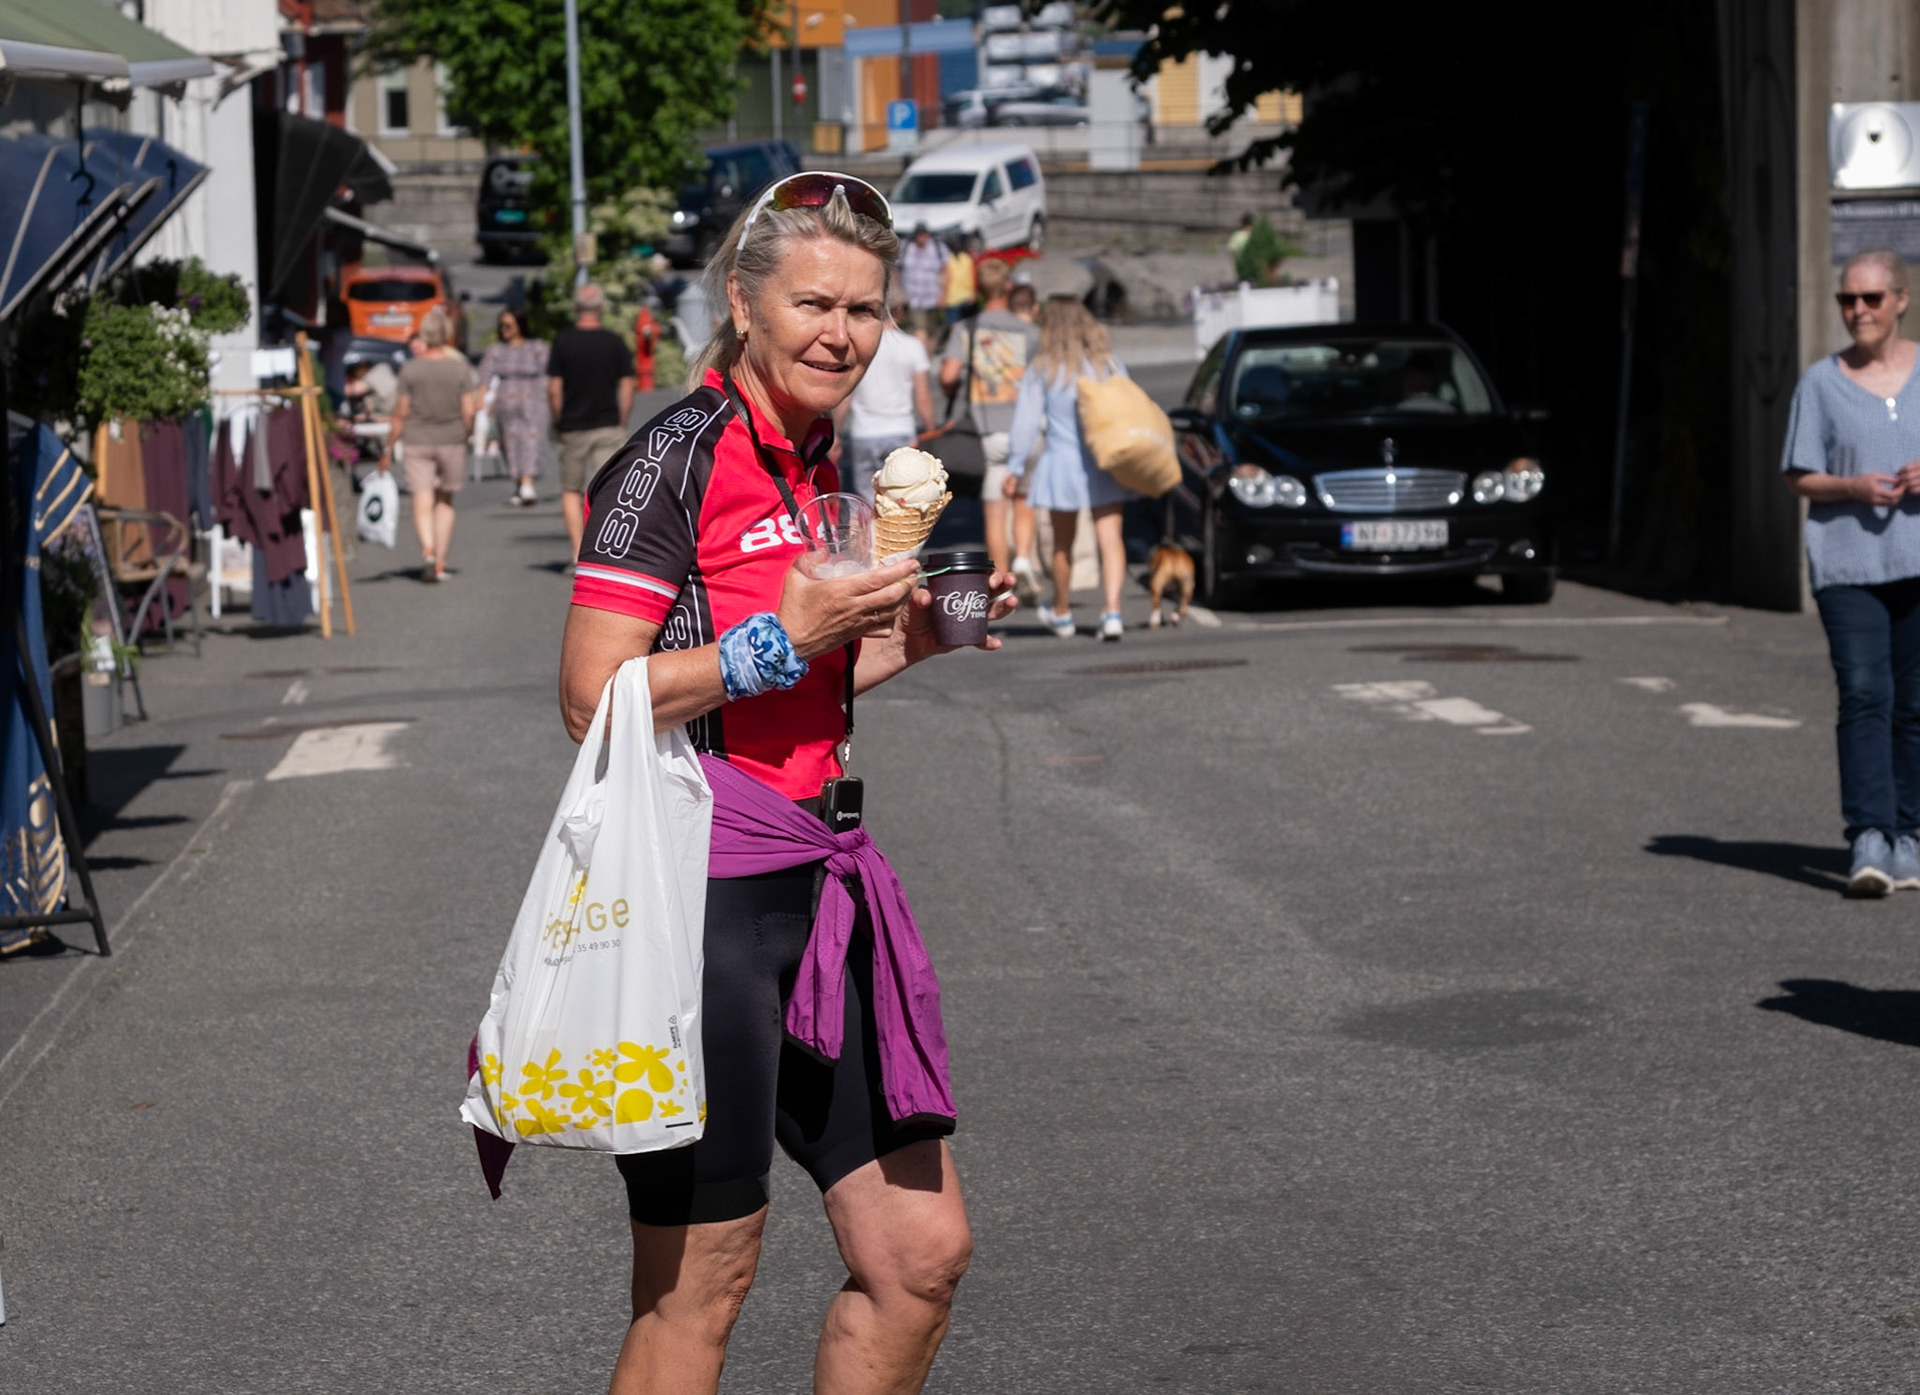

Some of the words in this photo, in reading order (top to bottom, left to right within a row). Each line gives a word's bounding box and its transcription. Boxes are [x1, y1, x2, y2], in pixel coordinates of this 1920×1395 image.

[894, 102, 911, 126] P
[595, 407, 709, 559] 8848
[936, 590, 989, 623] Coffee
[970, 611, 987, 619] TIME
[577, 944, 587, 953] 35
[589, 942, 599, 951] 49
[600, 940, 610, 949] 90
[611, 939, 621, 948] 30
